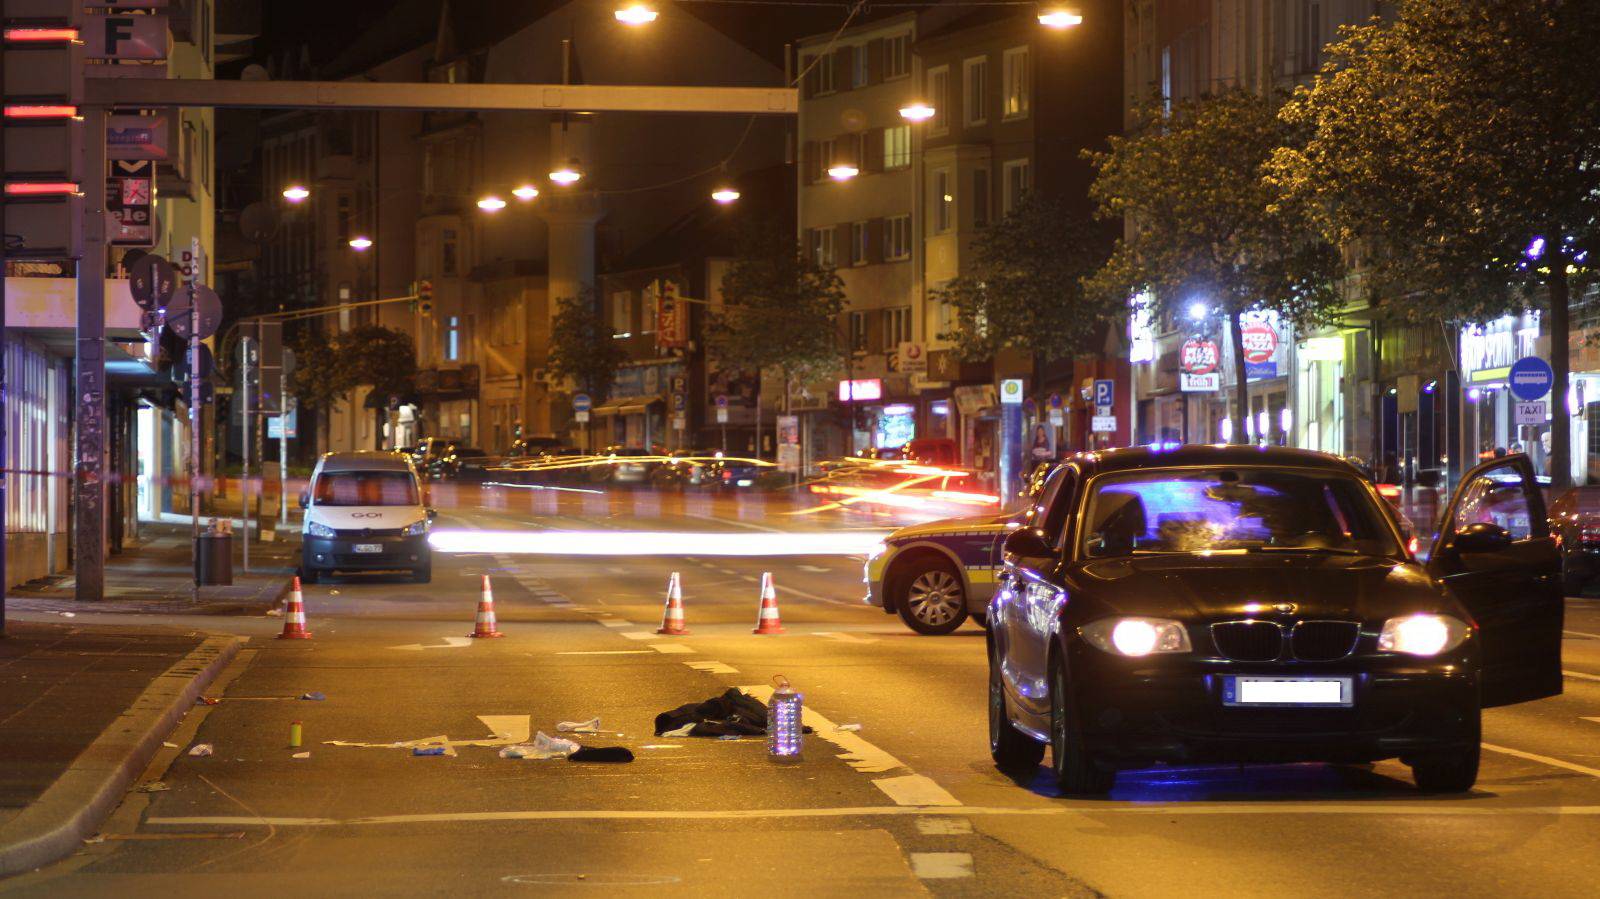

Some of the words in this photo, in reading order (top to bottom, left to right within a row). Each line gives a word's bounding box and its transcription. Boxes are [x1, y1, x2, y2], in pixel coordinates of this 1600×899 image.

[113, 208, 147, 222] ele
[1098, 383, 1108, 404] P
[1519, 405, 1542, 415] TAXI
